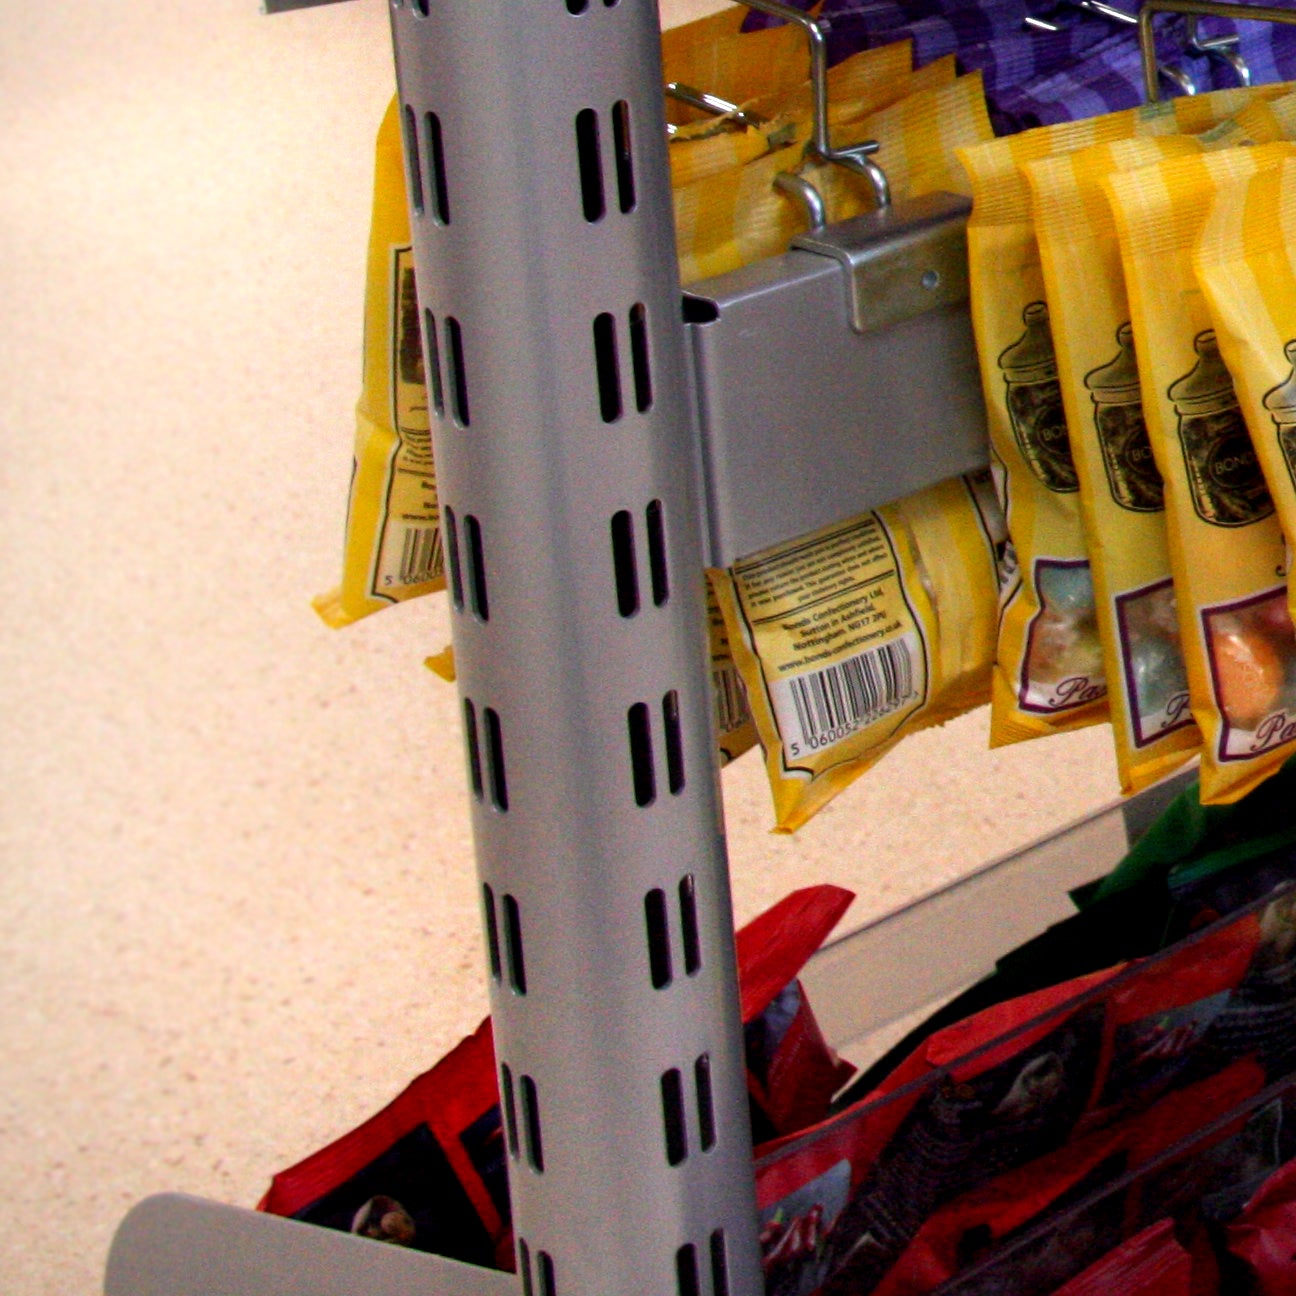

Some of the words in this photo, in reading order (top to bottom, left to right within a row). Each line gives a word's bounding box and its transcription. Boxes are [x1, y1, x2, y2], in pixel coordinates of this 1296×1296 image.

[813, 596, 869, 622] Confectionery
[800, 624, 830, 638] Sutton
[790, 743, 800, 756] 5
